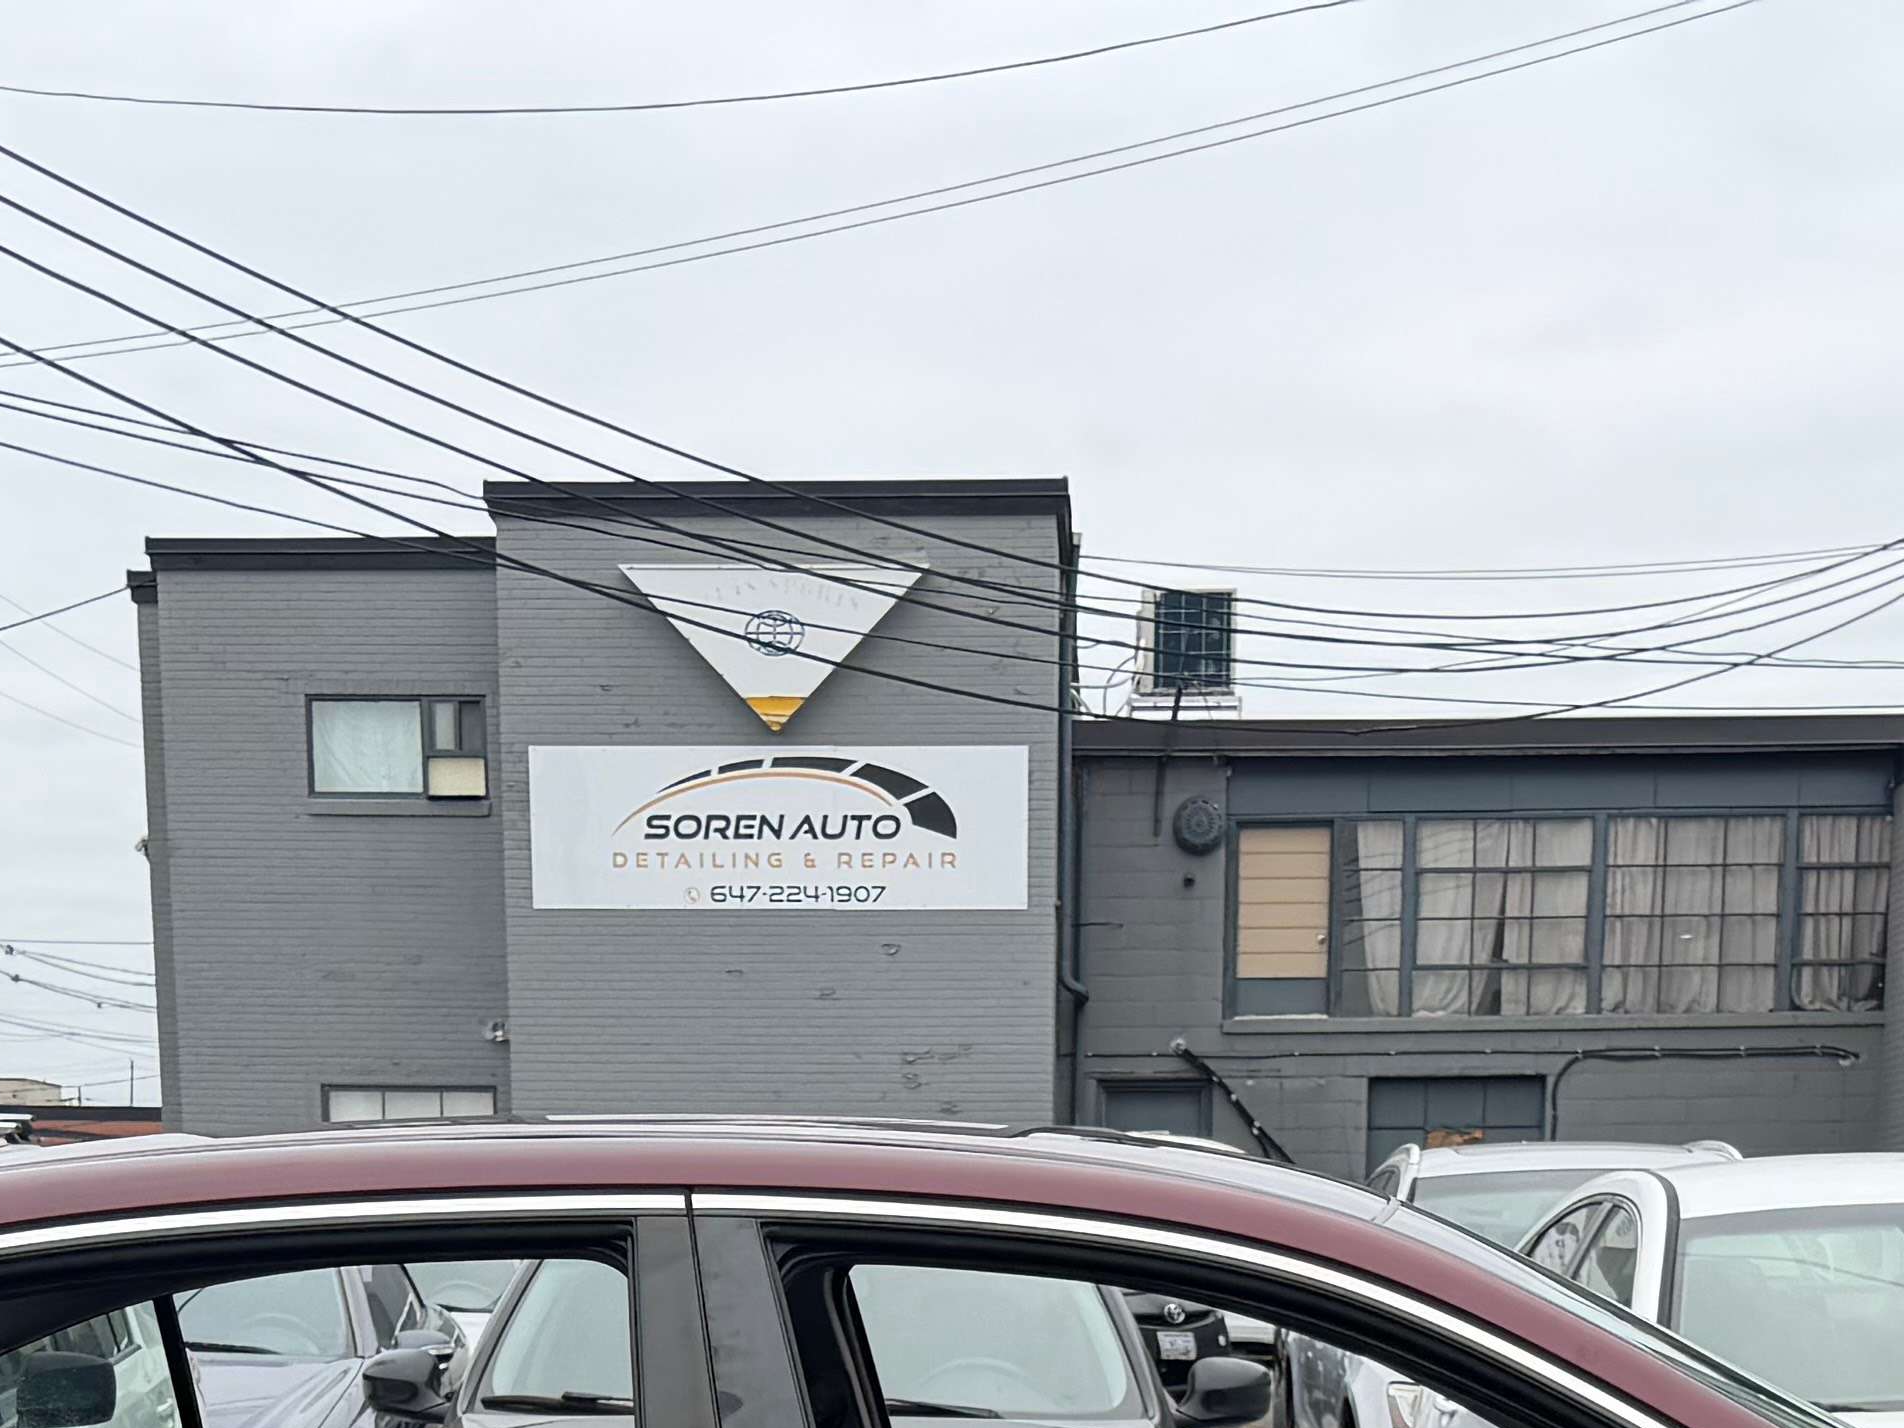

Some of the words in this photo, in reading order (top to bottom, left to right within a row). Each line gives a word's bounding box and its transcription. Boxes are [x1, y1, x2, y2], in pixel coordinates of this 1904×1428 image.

[643, 814, 786, 841] SOREN
[788, 814, 902, 841] AUTO
[611, 852, 784, 869] DETAILING
[803, 852, 818, 869] &
[836, 852, 959, 869] REPAIR
[710, 885, 887, 903] 647-224-1907
